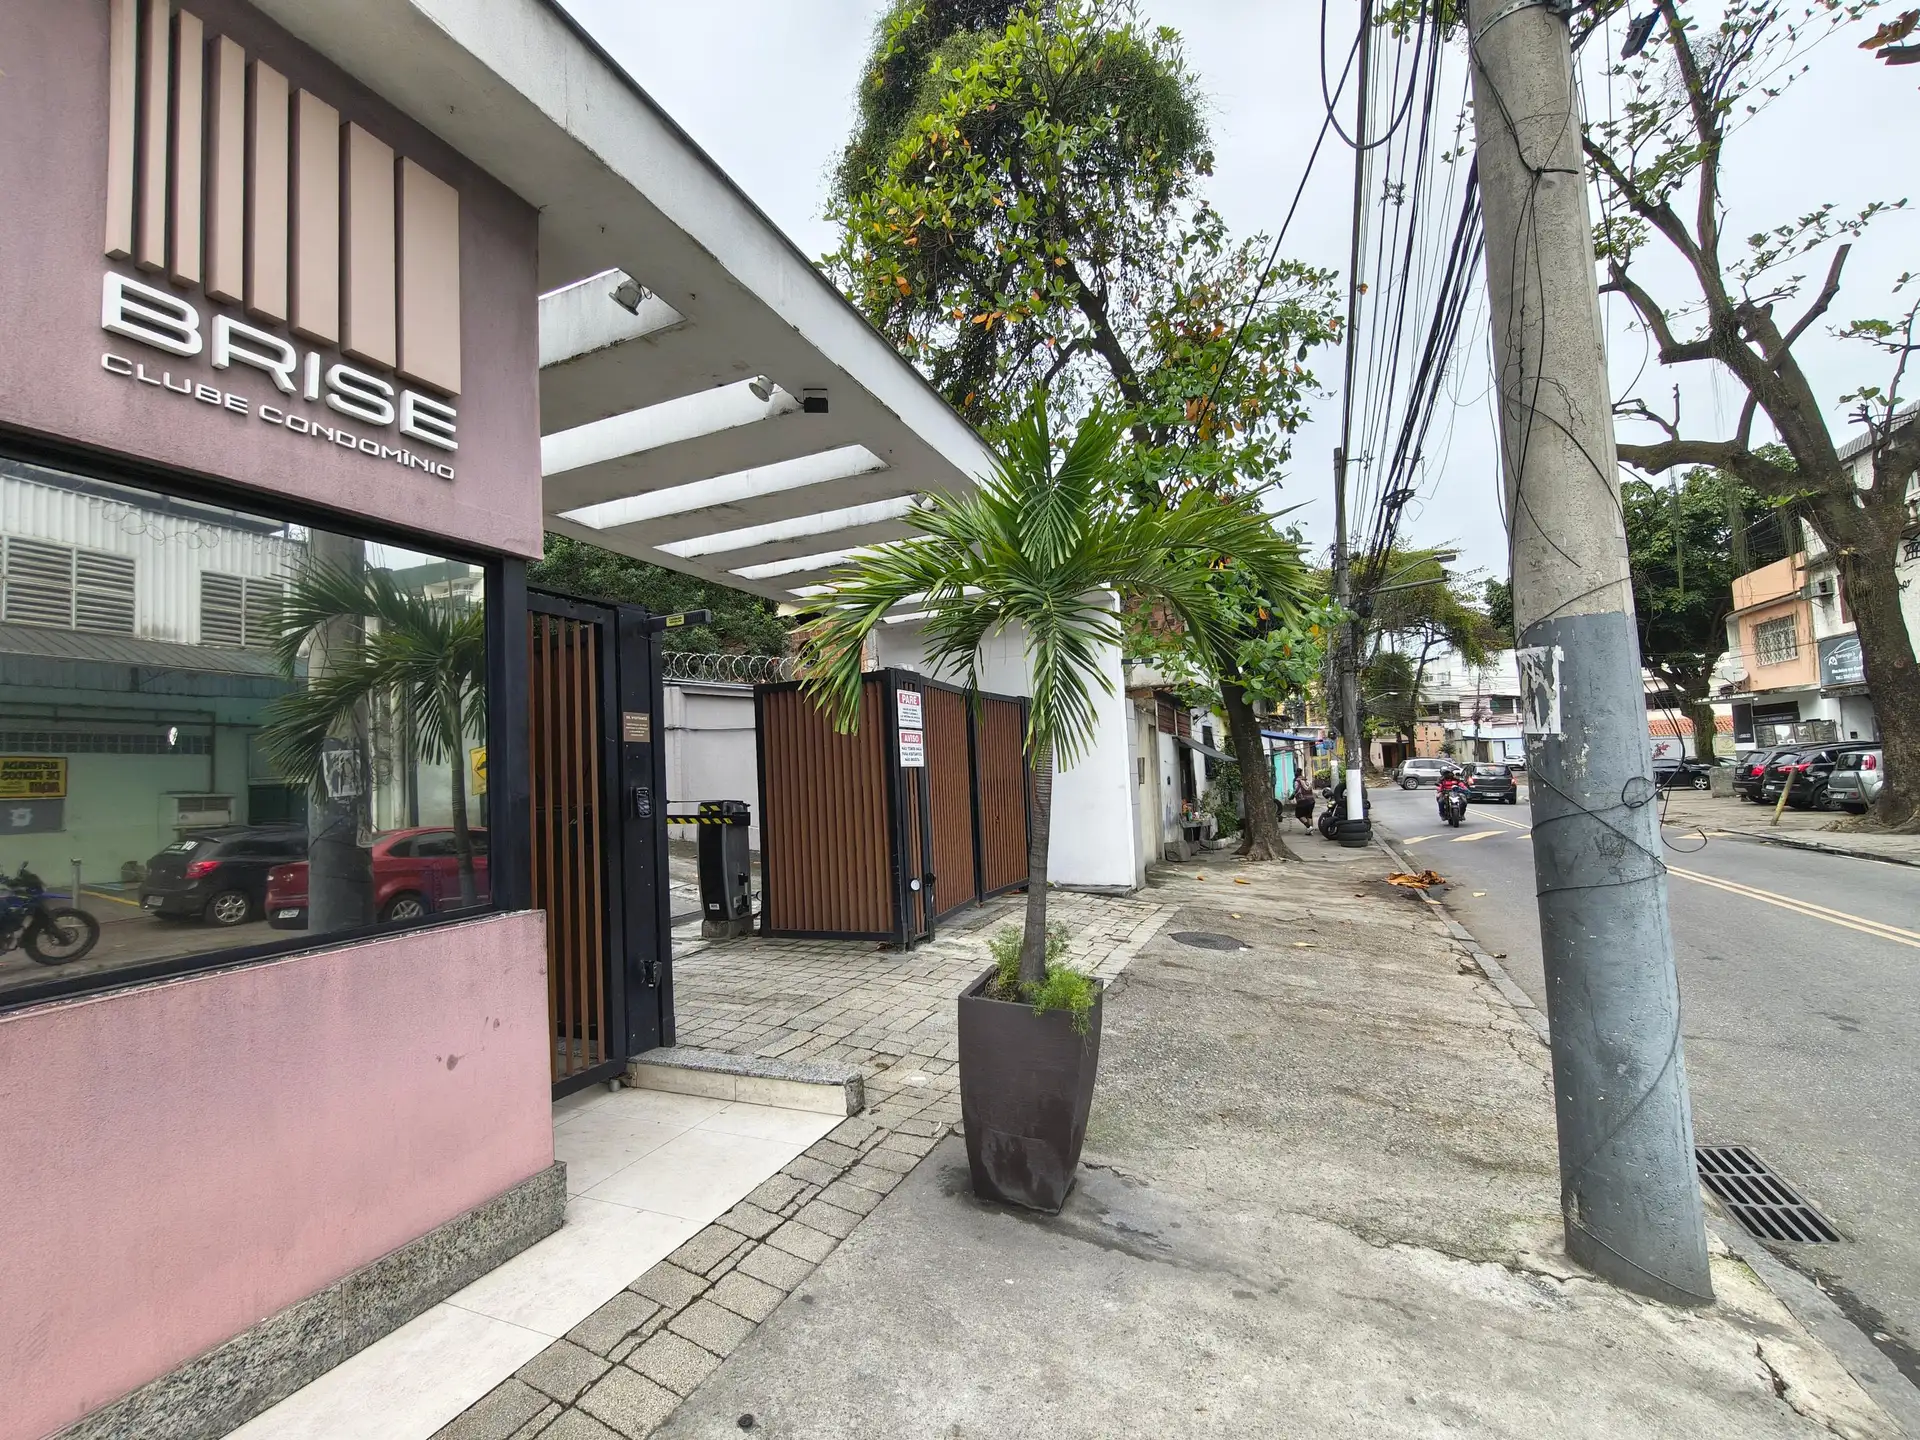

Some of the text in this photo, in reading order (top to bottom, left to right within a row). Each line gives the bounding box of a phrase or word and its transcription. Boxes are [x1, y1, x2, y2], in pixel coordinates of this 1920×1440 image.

[102, 271, 459, 451] BRISE
[101, 352, 456, 481] CLUBE CONDOMÍNIO
[902, 695, 918, 705] PARE
[904, 734, 919, 743] AVISO
